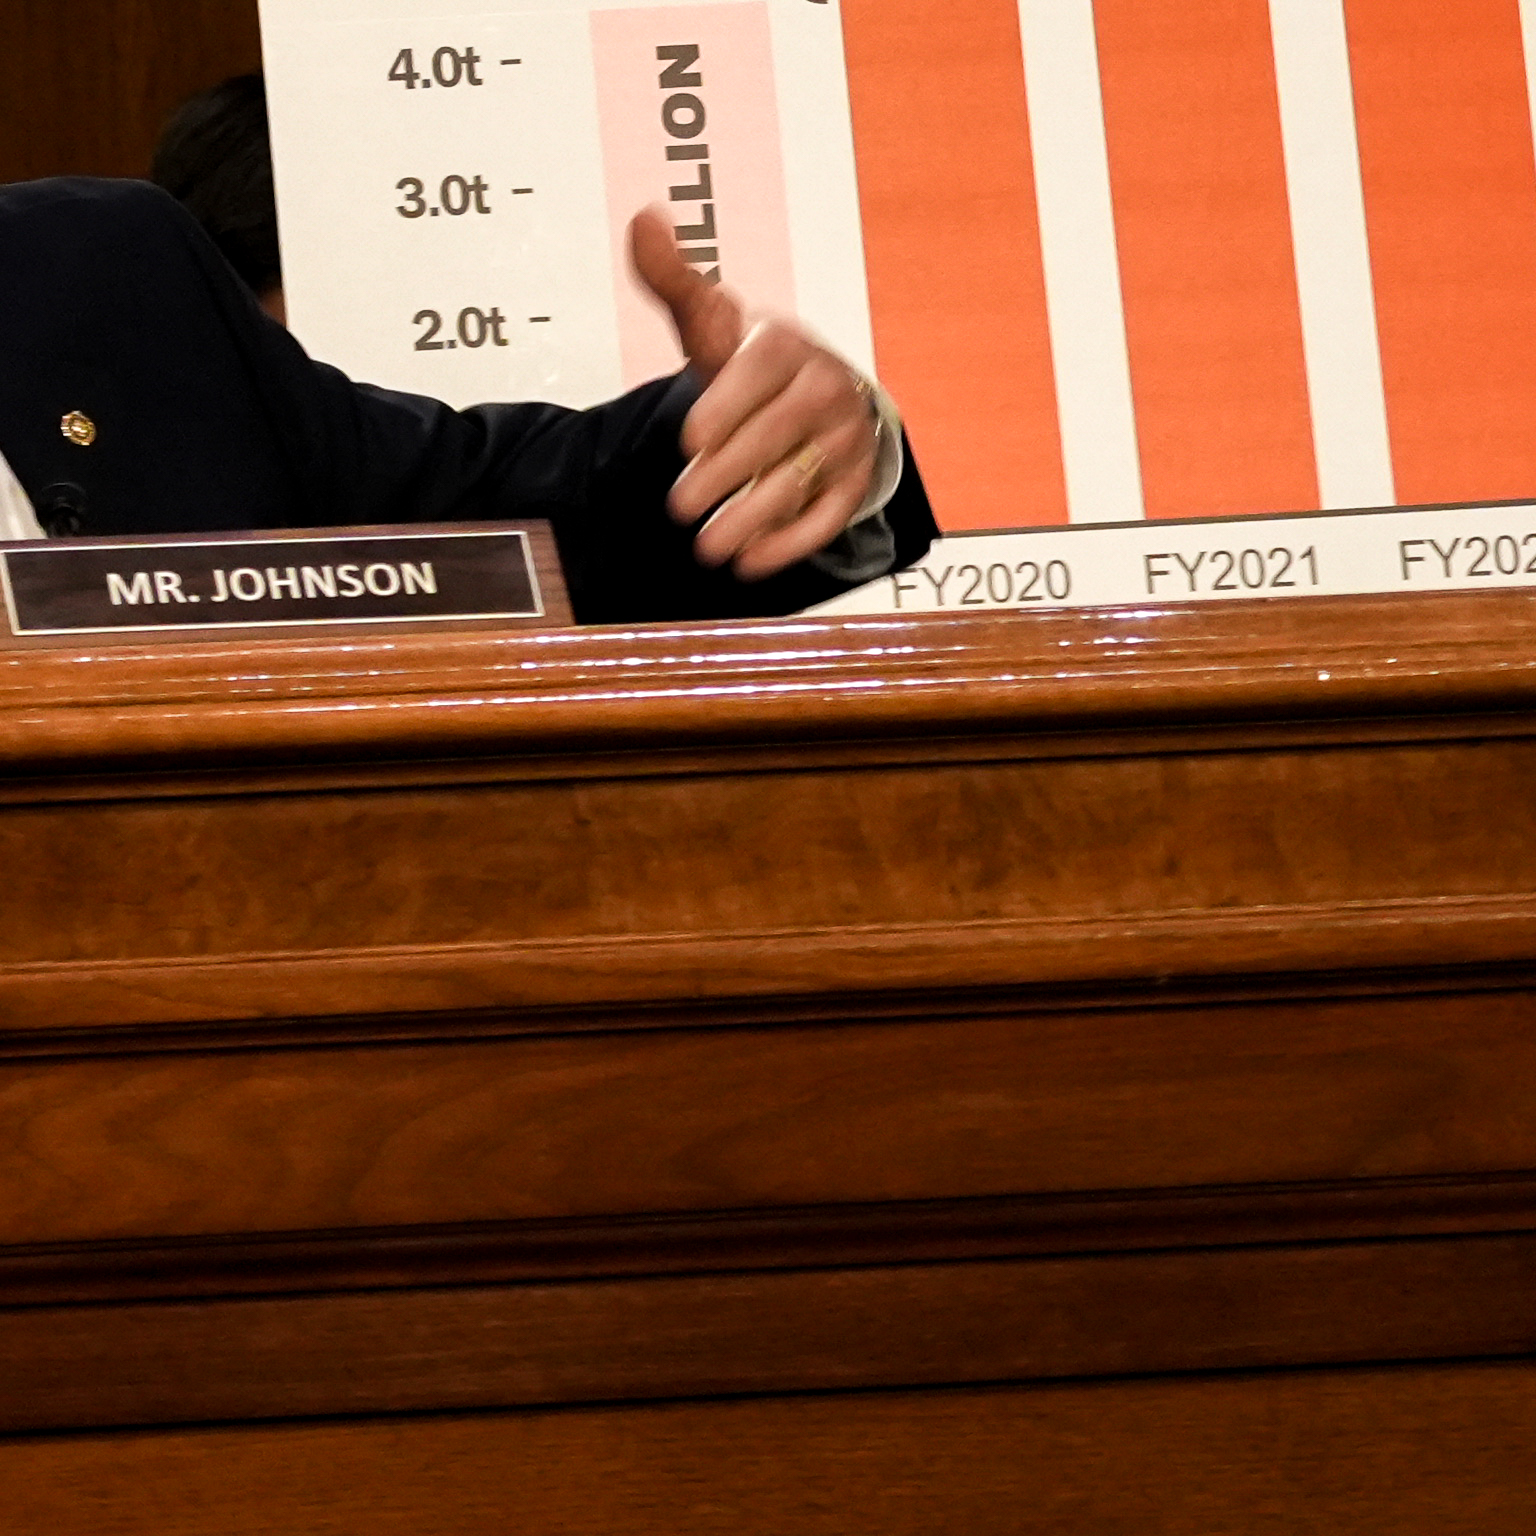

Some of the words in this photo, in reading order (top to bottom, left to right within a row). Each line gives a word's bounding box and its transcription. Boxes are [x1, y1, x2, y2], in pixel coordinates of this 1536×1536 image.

[390, 48, 483, 90] 4.0t
[656, 44, 721, 287] ILLION
[398, 176, 491, 219] 3.0t
[415, 308, 508, 351] 2.0t
[105, 571, 201, 606] MR.
[210, 561, 439, 605] JOHNSON
[890, 559, 1072, 609] FY2020
[1144, 545, 1321, 597] FY2021
